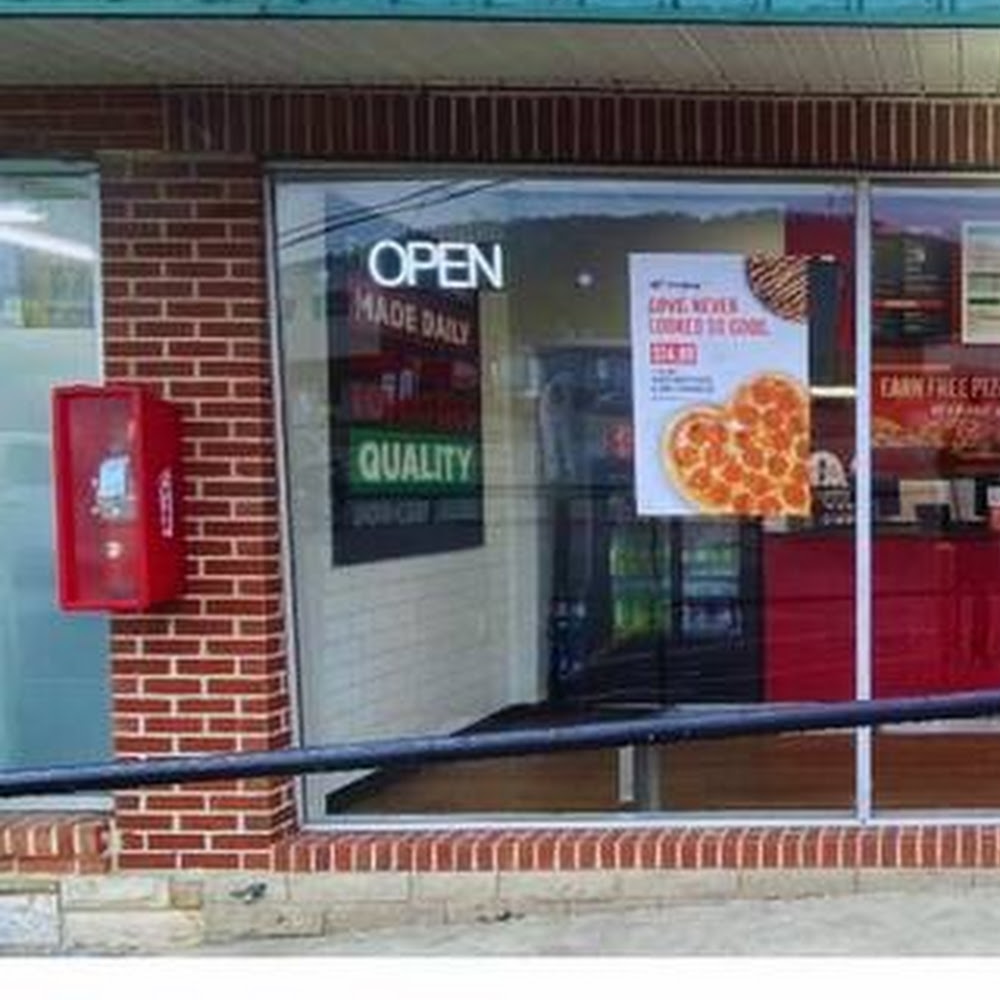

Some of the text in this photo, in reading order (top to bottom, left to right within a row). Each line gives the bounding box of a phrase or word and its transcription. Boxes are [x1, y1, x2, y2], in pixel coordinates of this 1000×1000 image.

[368, 239, 503, 289] OPEN
[354, 288, 470, 346] MADE DAILY
[359, 441, 473, 483] QUALITY
